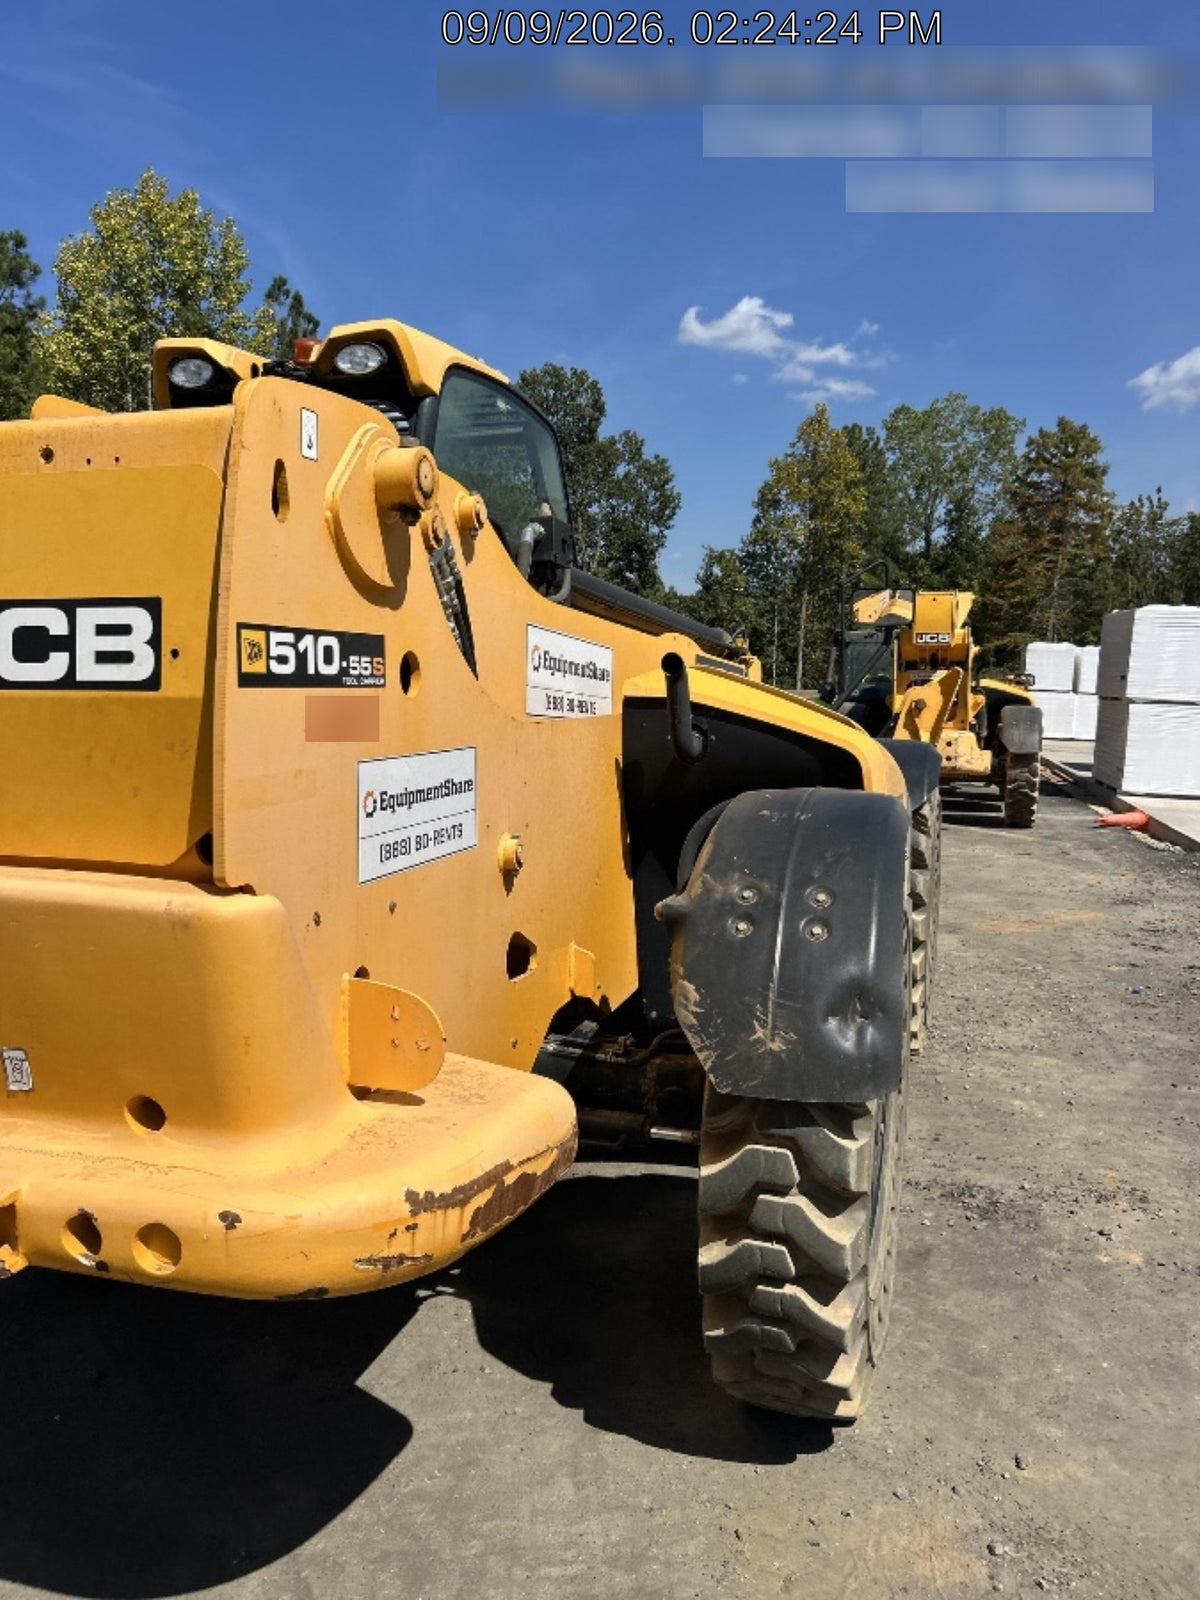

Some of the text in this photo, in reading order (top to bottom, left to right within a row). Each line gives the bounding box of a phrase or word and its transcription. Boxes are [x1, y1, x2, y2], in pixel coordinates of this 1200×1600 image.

[917, 633, 950, 643] JCB
[543, 649, 611, 683] EquipmentShare
[378, 777, 475, 815] EquipmentShare
